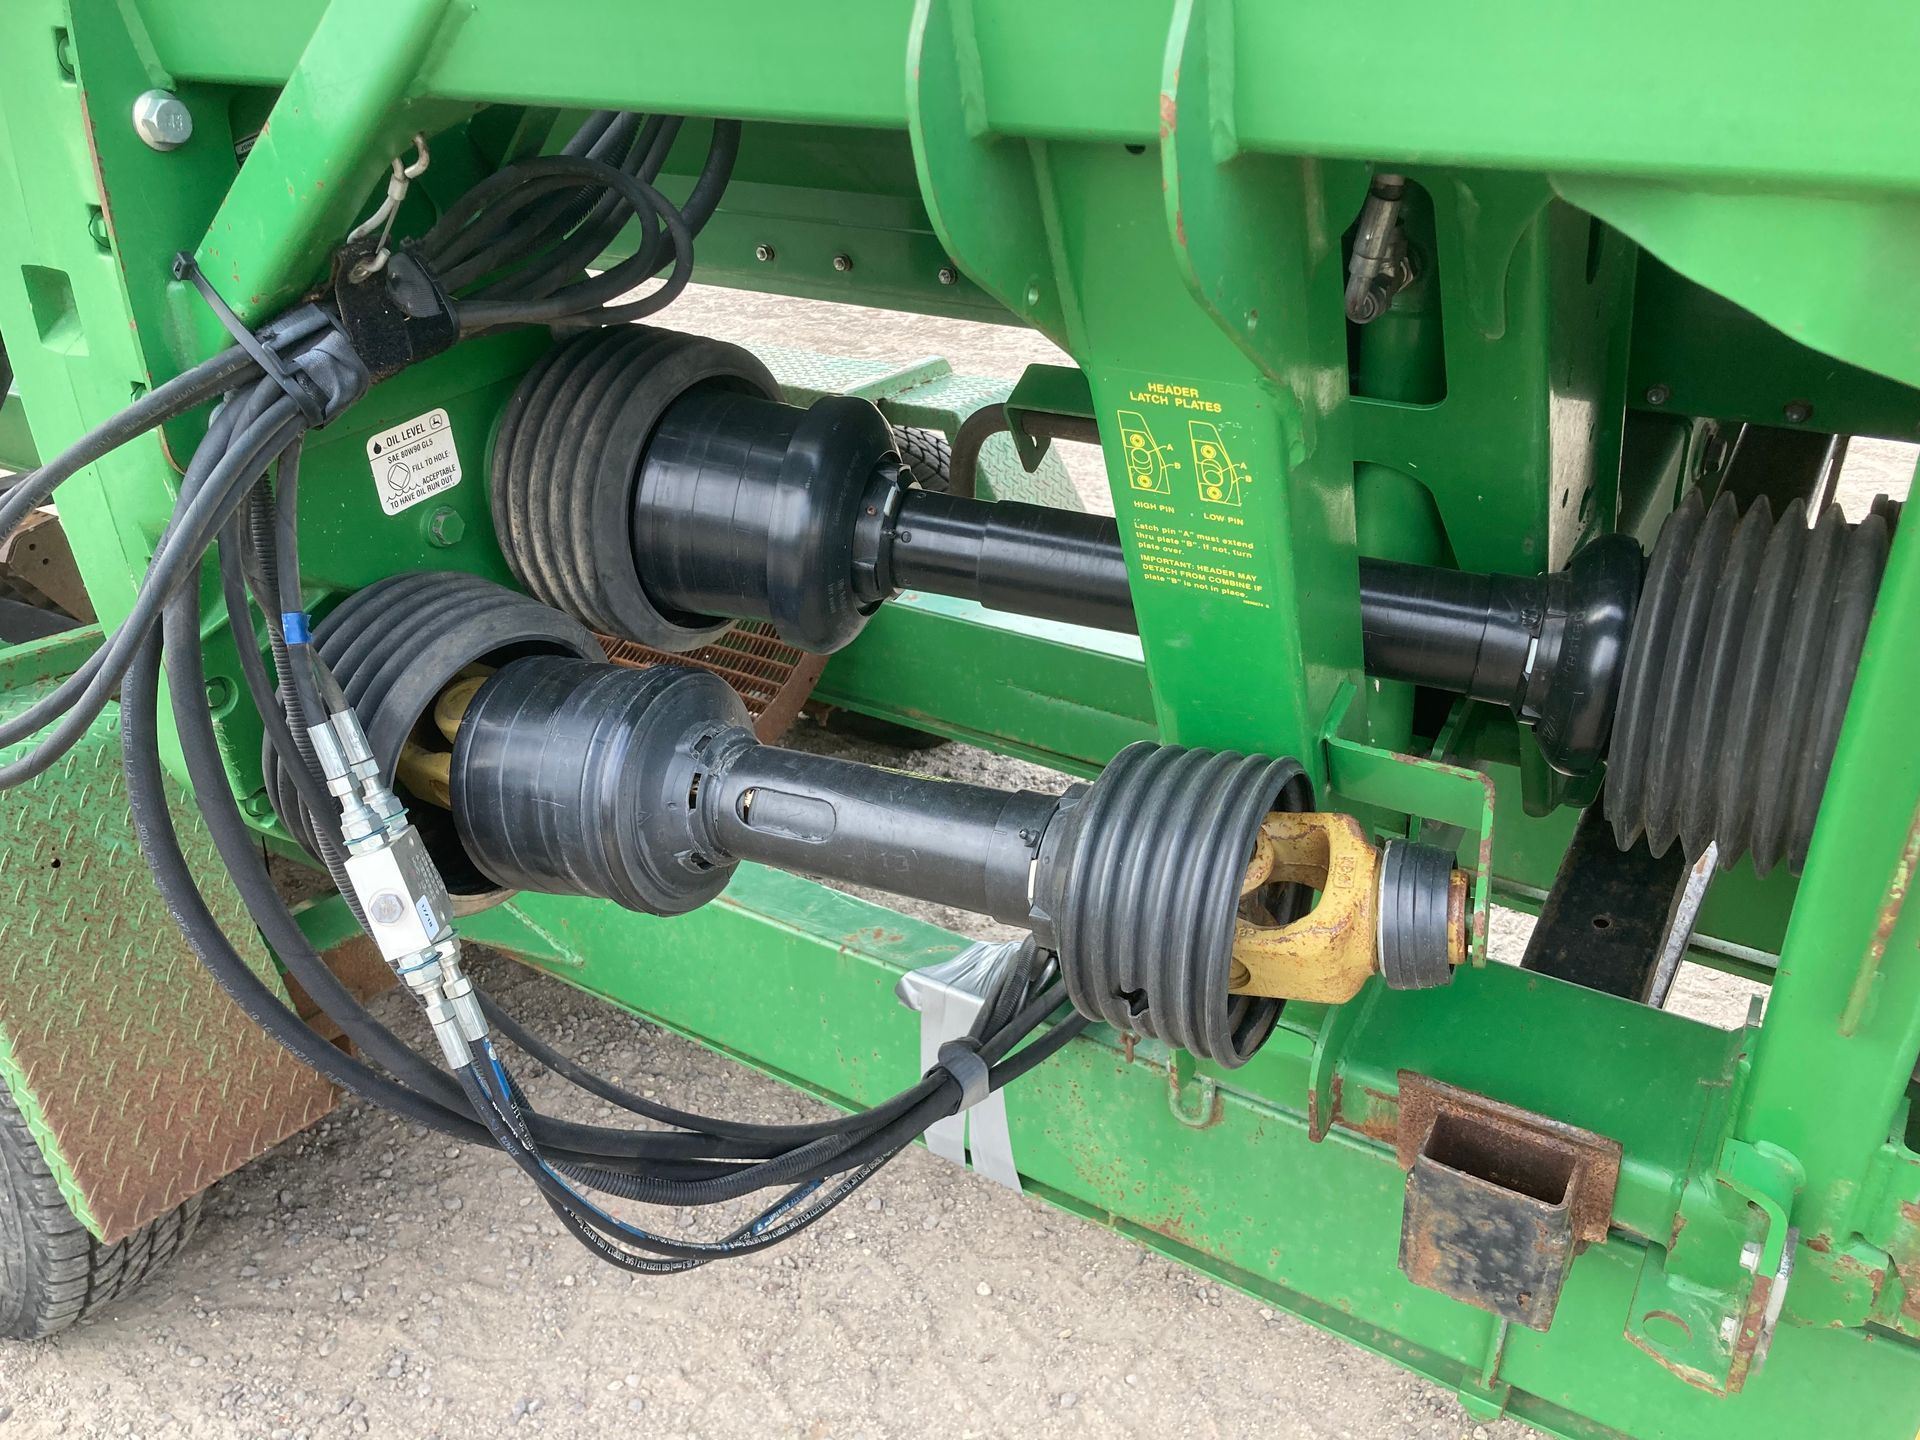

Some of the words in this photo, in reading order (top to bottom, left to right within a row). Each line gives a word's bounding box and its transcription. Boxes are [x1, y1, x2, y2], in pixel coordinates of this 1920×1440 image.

[1130, 392, 1168, 405] LATCH
[1175, 398, 1222, 412] PLATES
[1148, 383, 1199, 398] HEADER
[387, 435, 400, 447] OIL
[402, 424, 426, 440] LEVEL
[388, 454, 399, 464] SAE
[401, 444, 420, 458] 80W90
[422, 439, 433, 449] GL5
[412, 463, 424, 472] FILL
[425, 458, 433, 466] TO
[435, 450, 448, 463] HOLE
[423, 464, 456, 485] ACCEPTABLE
[391, 500, 399, 509] TO
[400, 493, 415, 505] HAVE
[416, 488, 425, 497] OIL
[427, 481, 440, 492] RUN
[441, 475, 453, 485] OUT
[1134, 501, 1156, 510] HIGH
[1159, 504, 1175, 513] PIN
[1204, 513, 1224, 522] LOW
[1228, 516, 1243, 525] PIN
[1134, 522, 1159, 532] Latch
[1162, 527, 1176, 535] pin
[1197, 533, 1219, 543] must
[1222, 539, 1254, 549] extend
[1136, 532, 1154, 540] thru
[1157, 536, 1179, 545] plate
[1232, 550, 1252, 558] turn
[1138, 542, 1160, 551] plate
[1163, 546, 1184, 555] over.
[1141, 554, 1194, 570] IMPORTANT:
[1197, 565, 1235, 578] HEADER
[1238, 573, 1257, 582] MAY
[1143, 564, 1177, 575] DETACH
[1180, 570, 1205, 581] FROM
[1209, 576, 1251, 590] COMBINE
[1144, 573, 1165, 582] plate
[1194, 582, 1208, 590] not
[1222, 588, 1248, 599] place.
